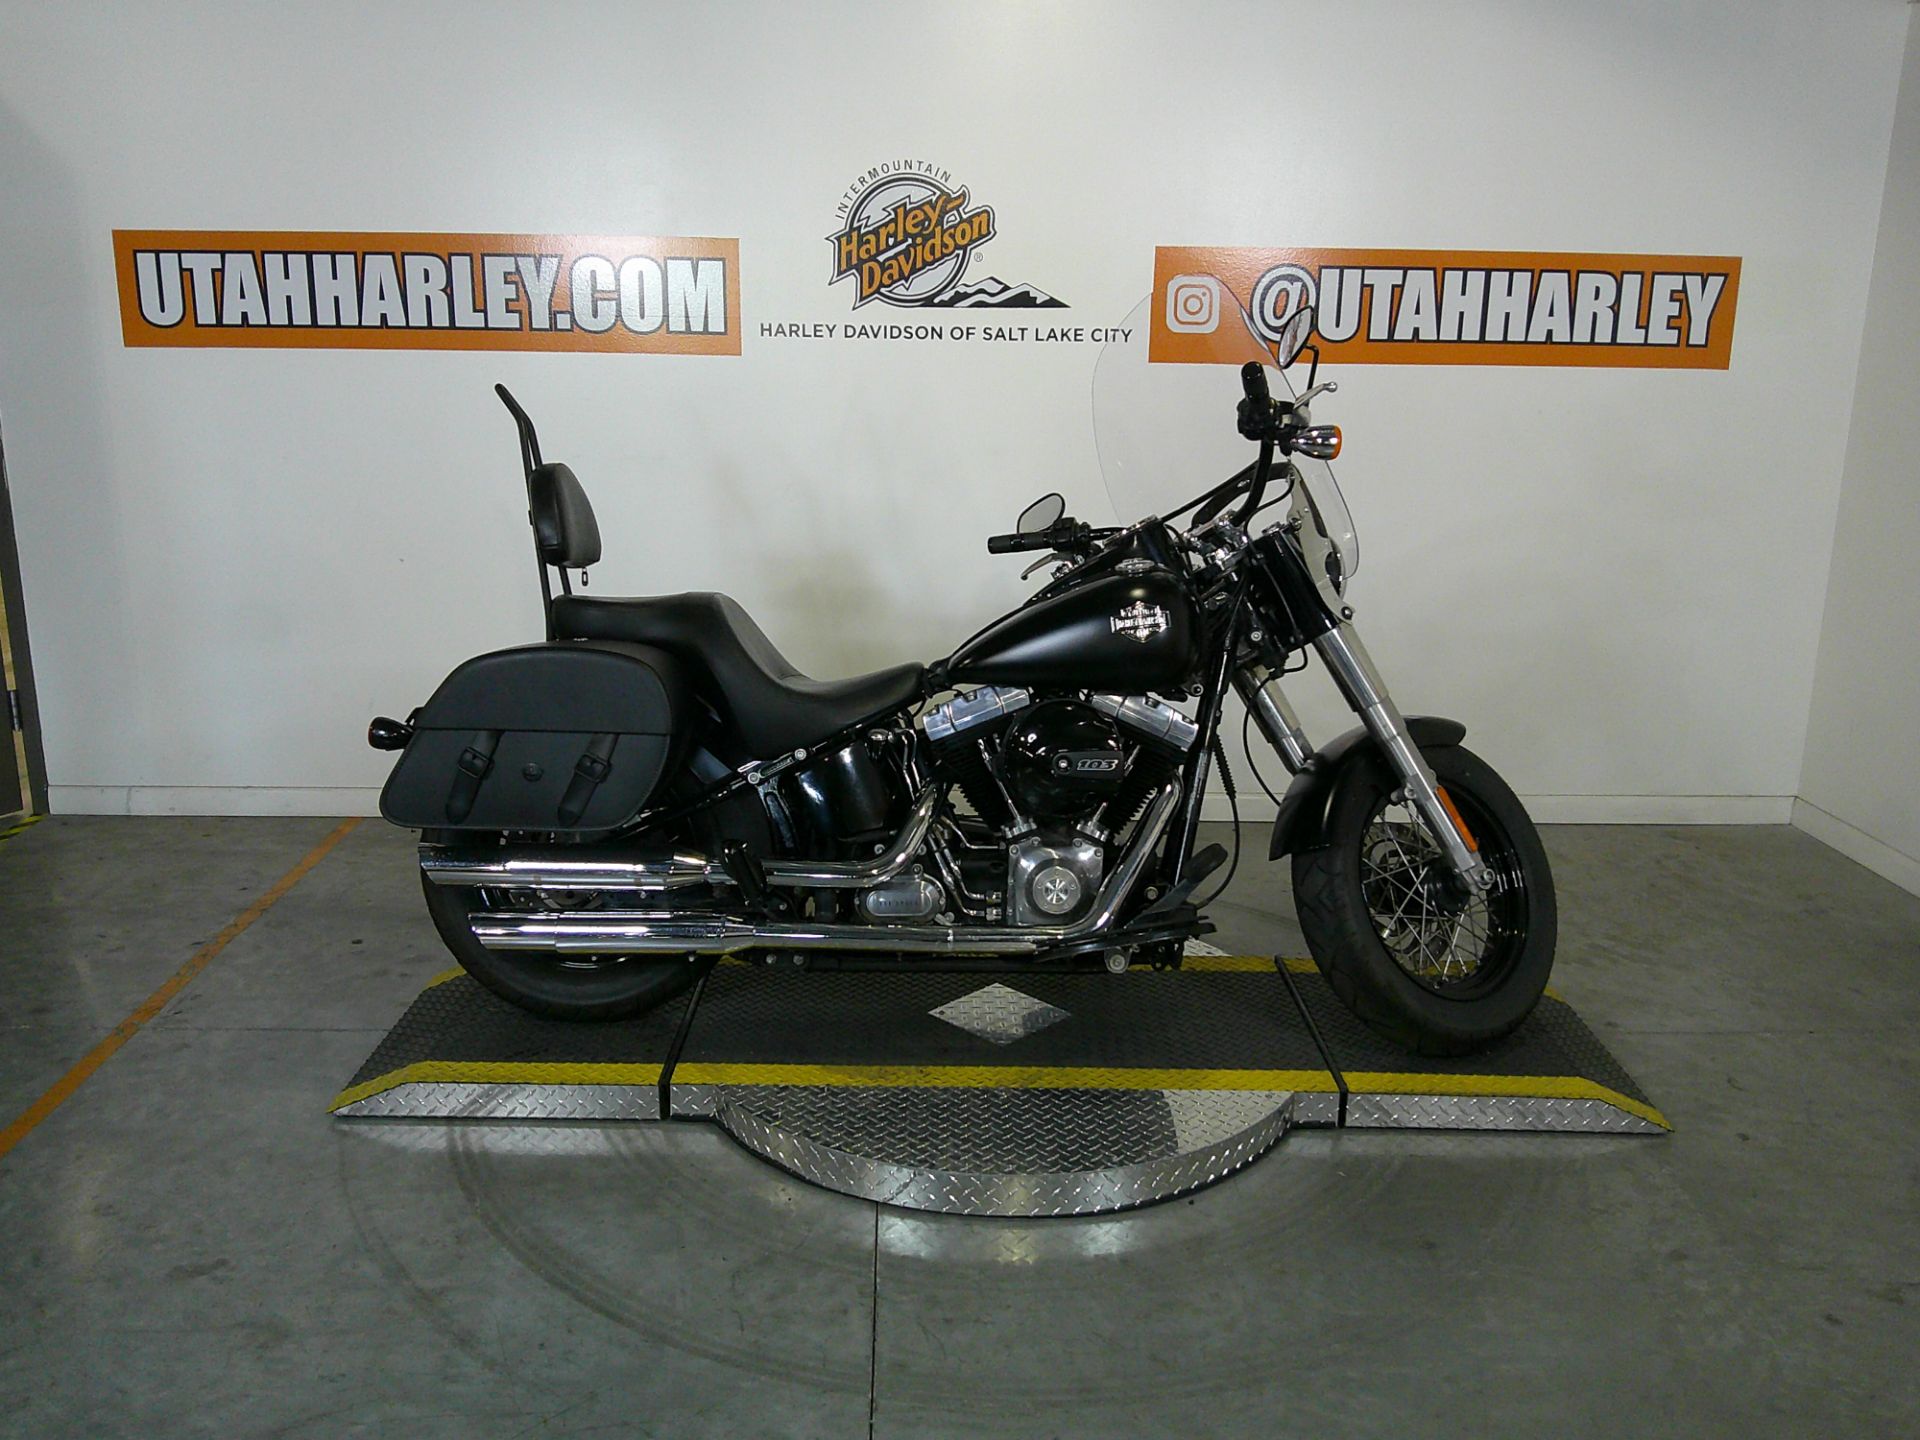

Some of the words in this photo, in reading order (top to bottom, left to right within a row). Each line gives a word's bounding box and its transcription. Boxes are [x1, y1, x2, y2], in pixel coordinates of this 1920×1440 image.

[835, 160, 951, 219] INTERMOUNTAIN
[861, 211, 989, 297] Davidson
[133, 249, 729, 336] UTAHHARLEY.COM
[1251, 262, 1729, 348] @UTAHHARLEY
[760, 323, 836, 338] HARLEY
[844, 325, 943, 340] DAVIDSON
[949, 326, 976, 340] OF
[982, 327, 1028, 342] SALT
[1034, 328, 1084, 342] LAKE
[1090, 328, 1133, 343] CITY
[1077, 759, 1119, 771] 103
